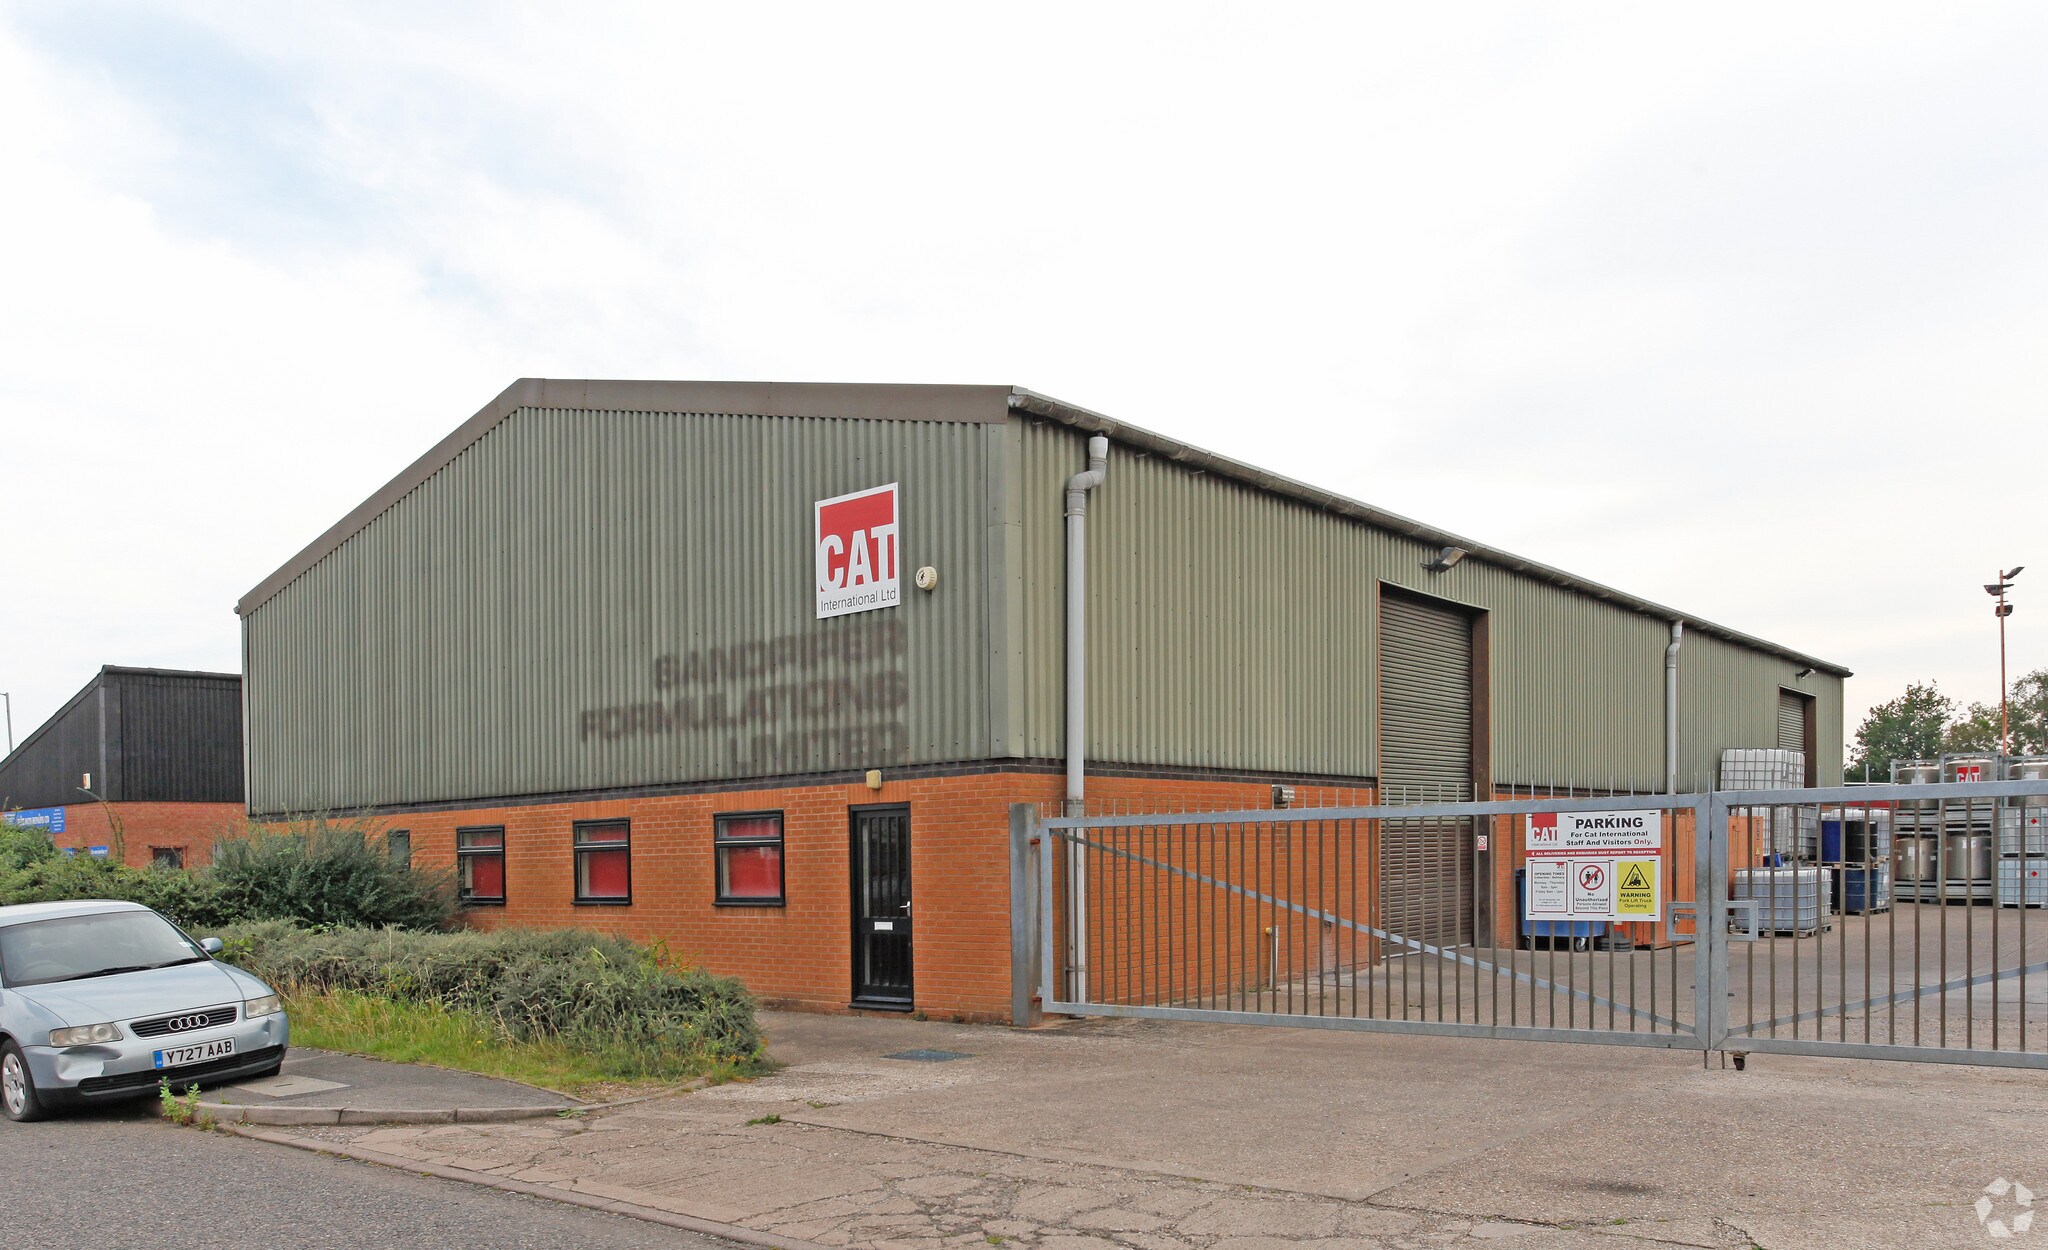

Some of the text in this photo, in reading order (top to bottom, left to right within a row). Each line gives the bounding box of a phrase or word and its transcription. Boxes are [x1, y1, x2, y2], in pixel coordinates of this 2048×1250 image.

[820, 523, 895, 591] CAT
[821, 587, 896, 612] International Ltd
[1575, 817, 1643, 829] PARKING
[1532, 826, 1557, 842] CAT
[1599, 830, 1648, 838] International
[1566, 839, 1584, 847] Staff
[1633, 838, 1653, 846] Only.
[166, 1047, 203, 1063] Y727
[207, 1041, 232, 1057] AAB
